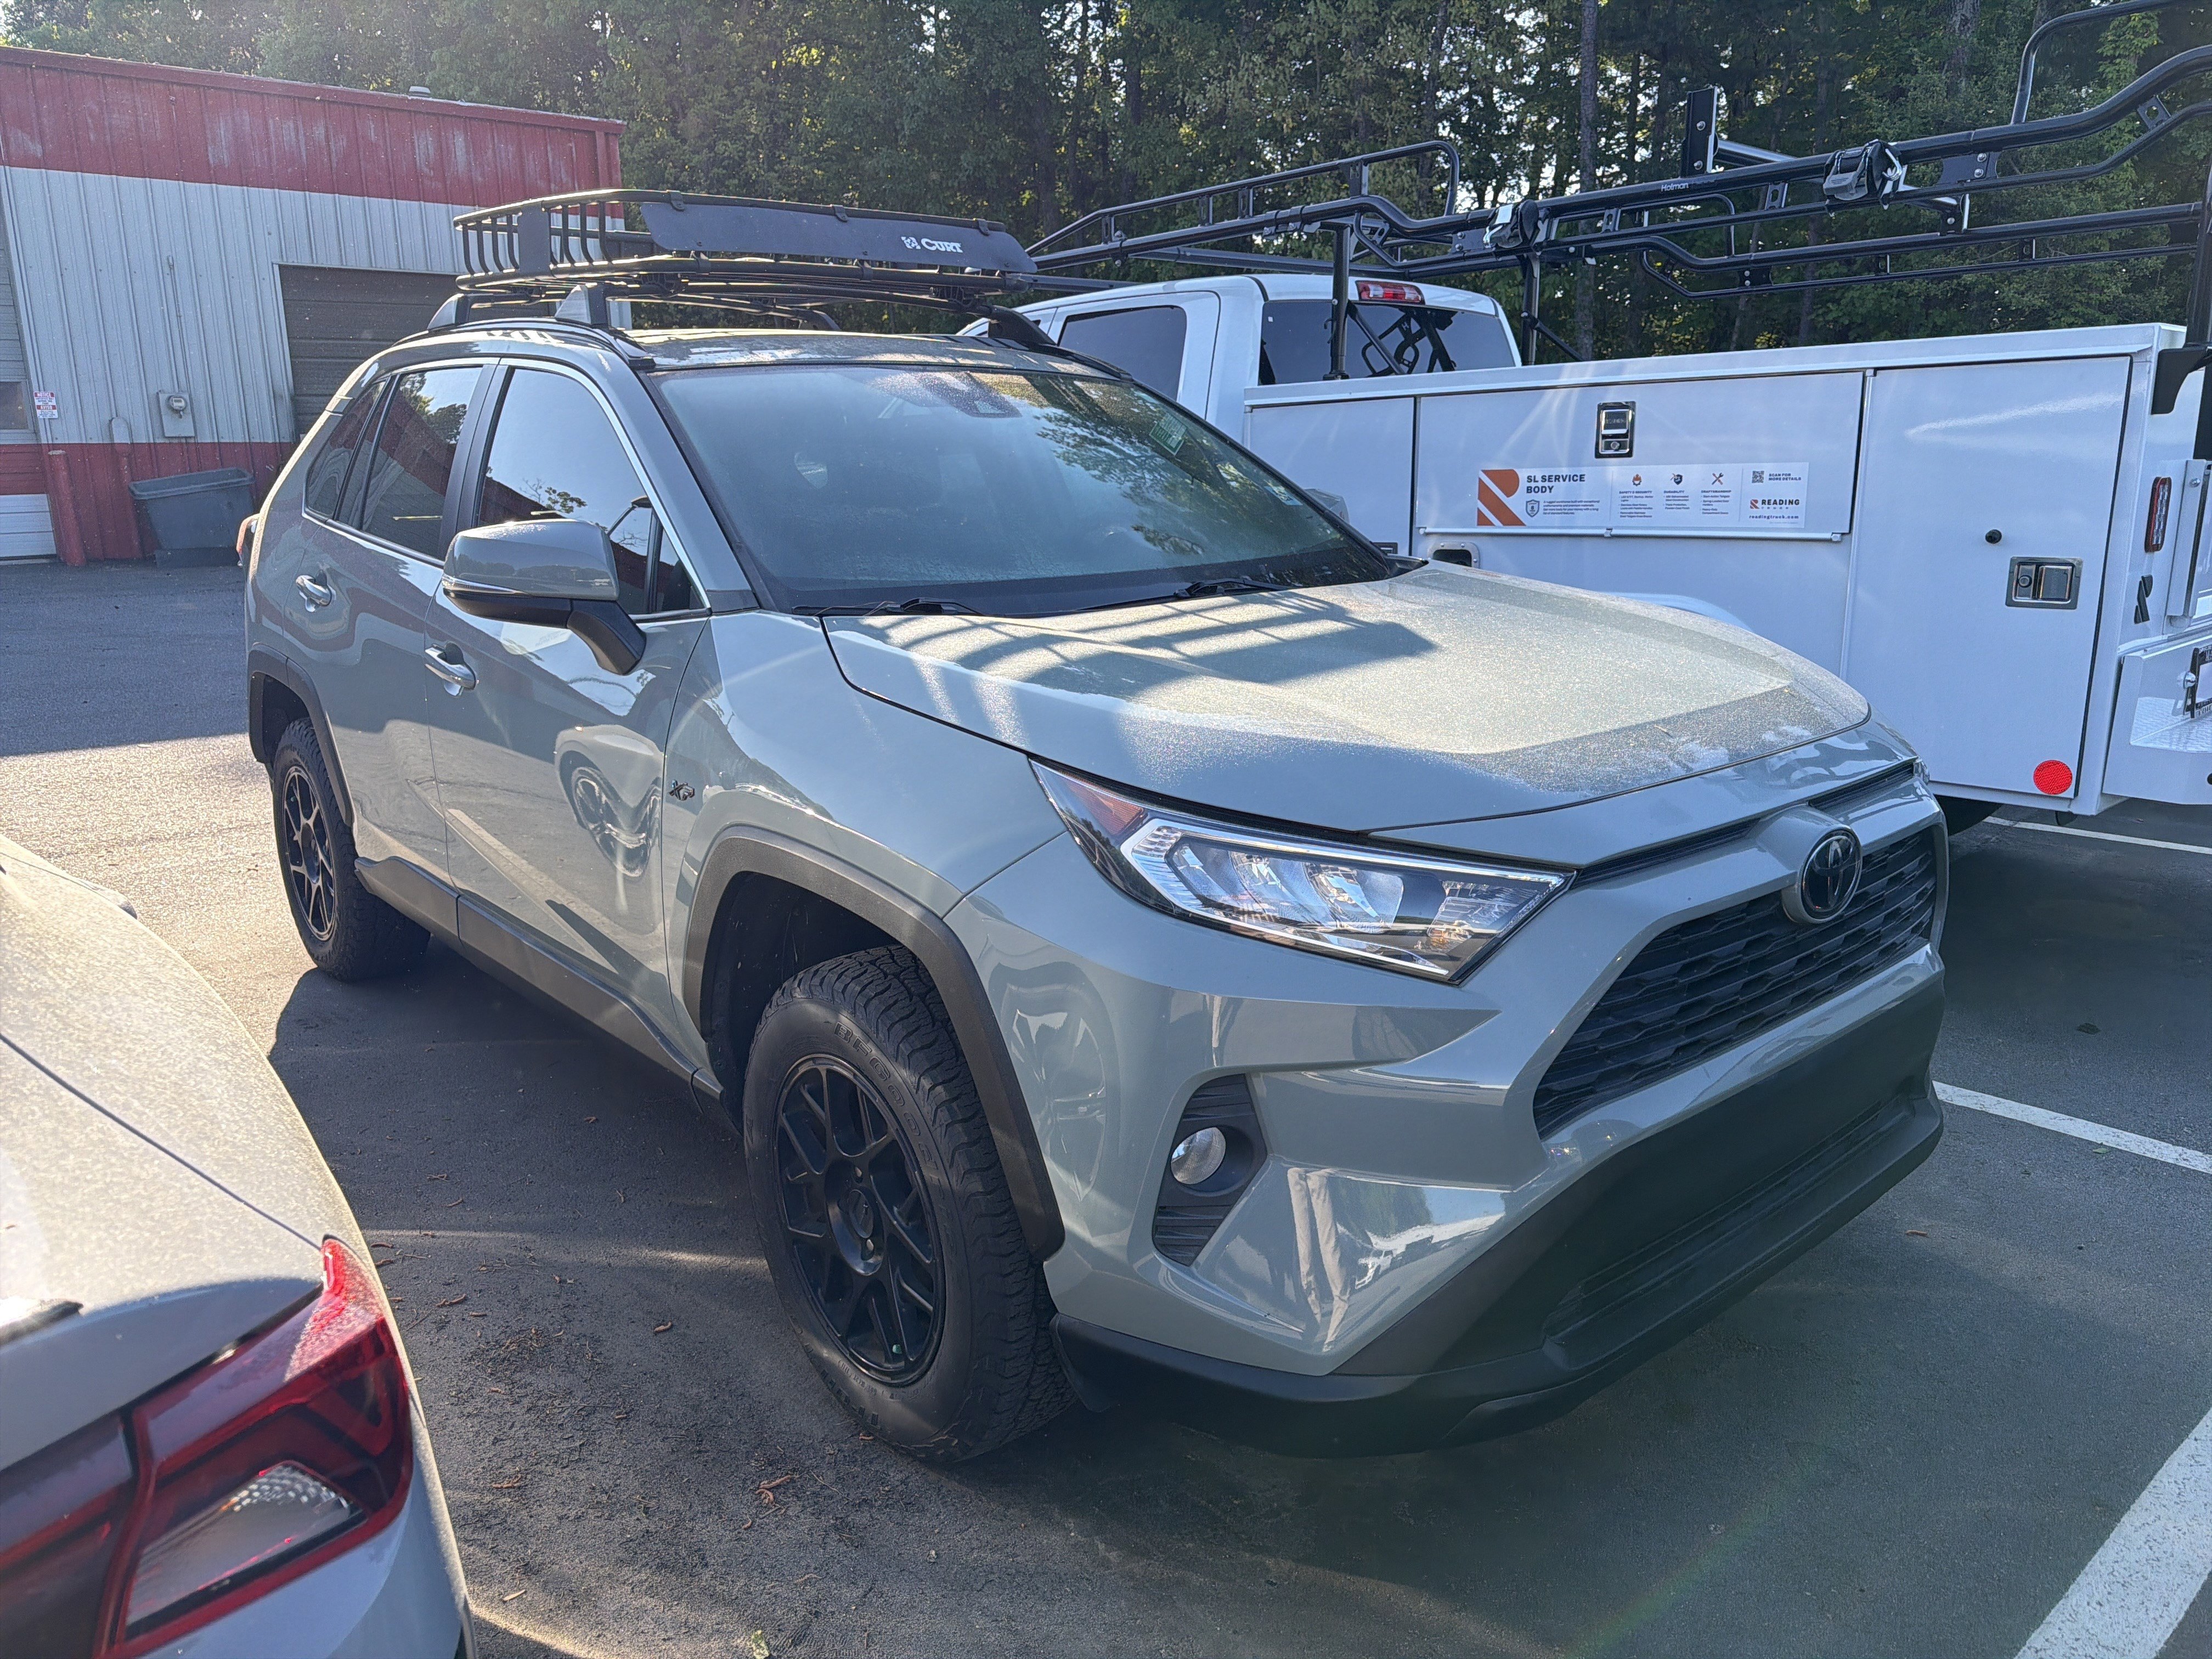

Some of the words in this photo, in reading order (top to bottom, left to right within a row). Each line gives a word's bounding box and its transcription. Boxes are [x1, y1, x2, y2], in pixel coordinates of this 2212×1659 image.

[1661, 183, 1689, 192] Holman
[921, 238, 963, 253] CURT
[1541, 474, 1585, 483] SERVICE
